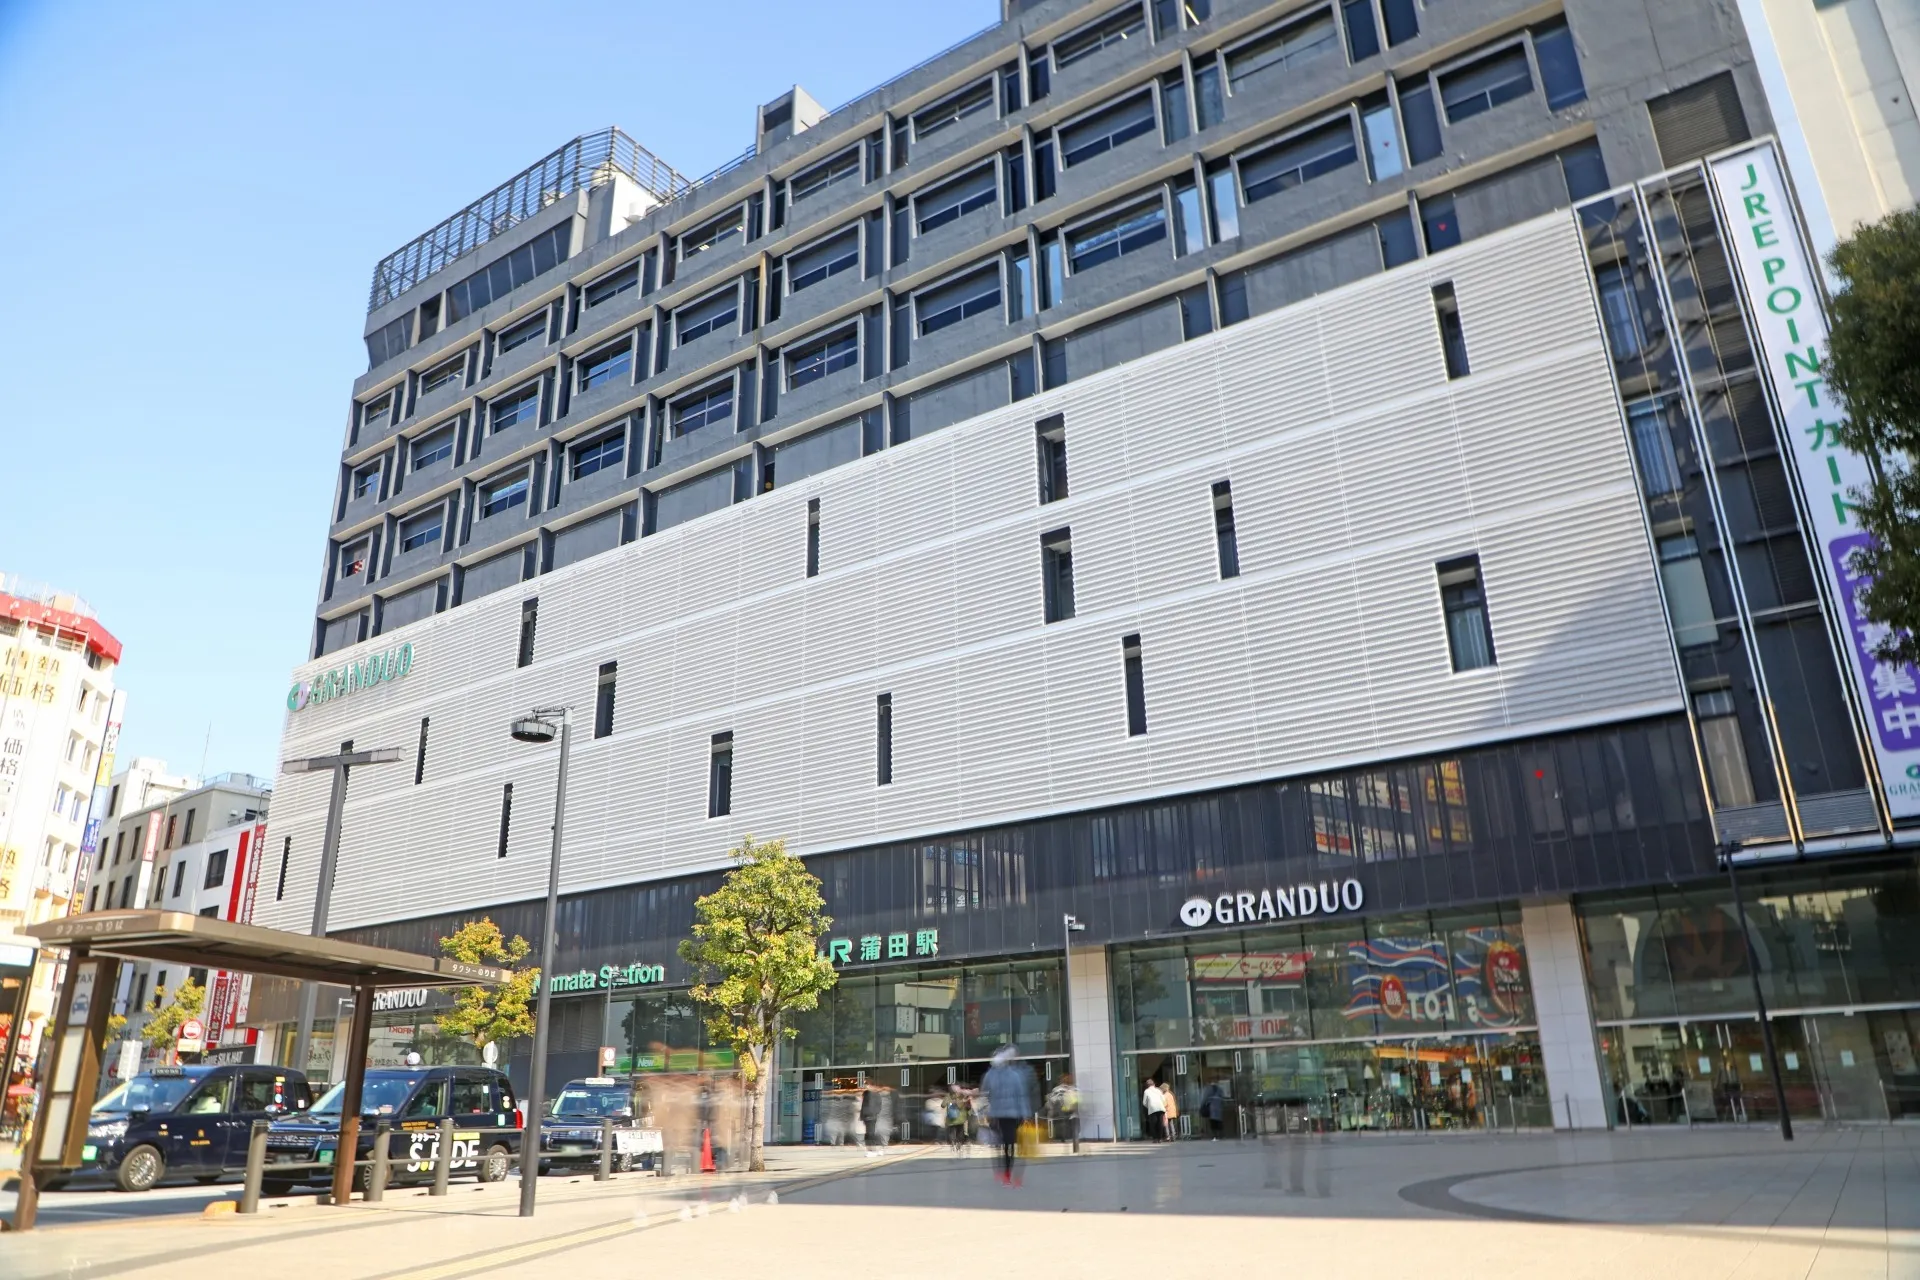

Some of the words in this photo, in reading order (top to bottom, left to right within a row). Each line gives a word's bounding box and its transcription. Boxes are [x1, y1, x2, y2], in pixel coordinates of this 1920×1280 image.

[310, 642, 415, 706] GRANDUO
[1215, 879, 1364, 925] GRANDUO
[860, 928, 939, 961] 蒲田駅
[452, 963, 497, 979] タクシーのりば
